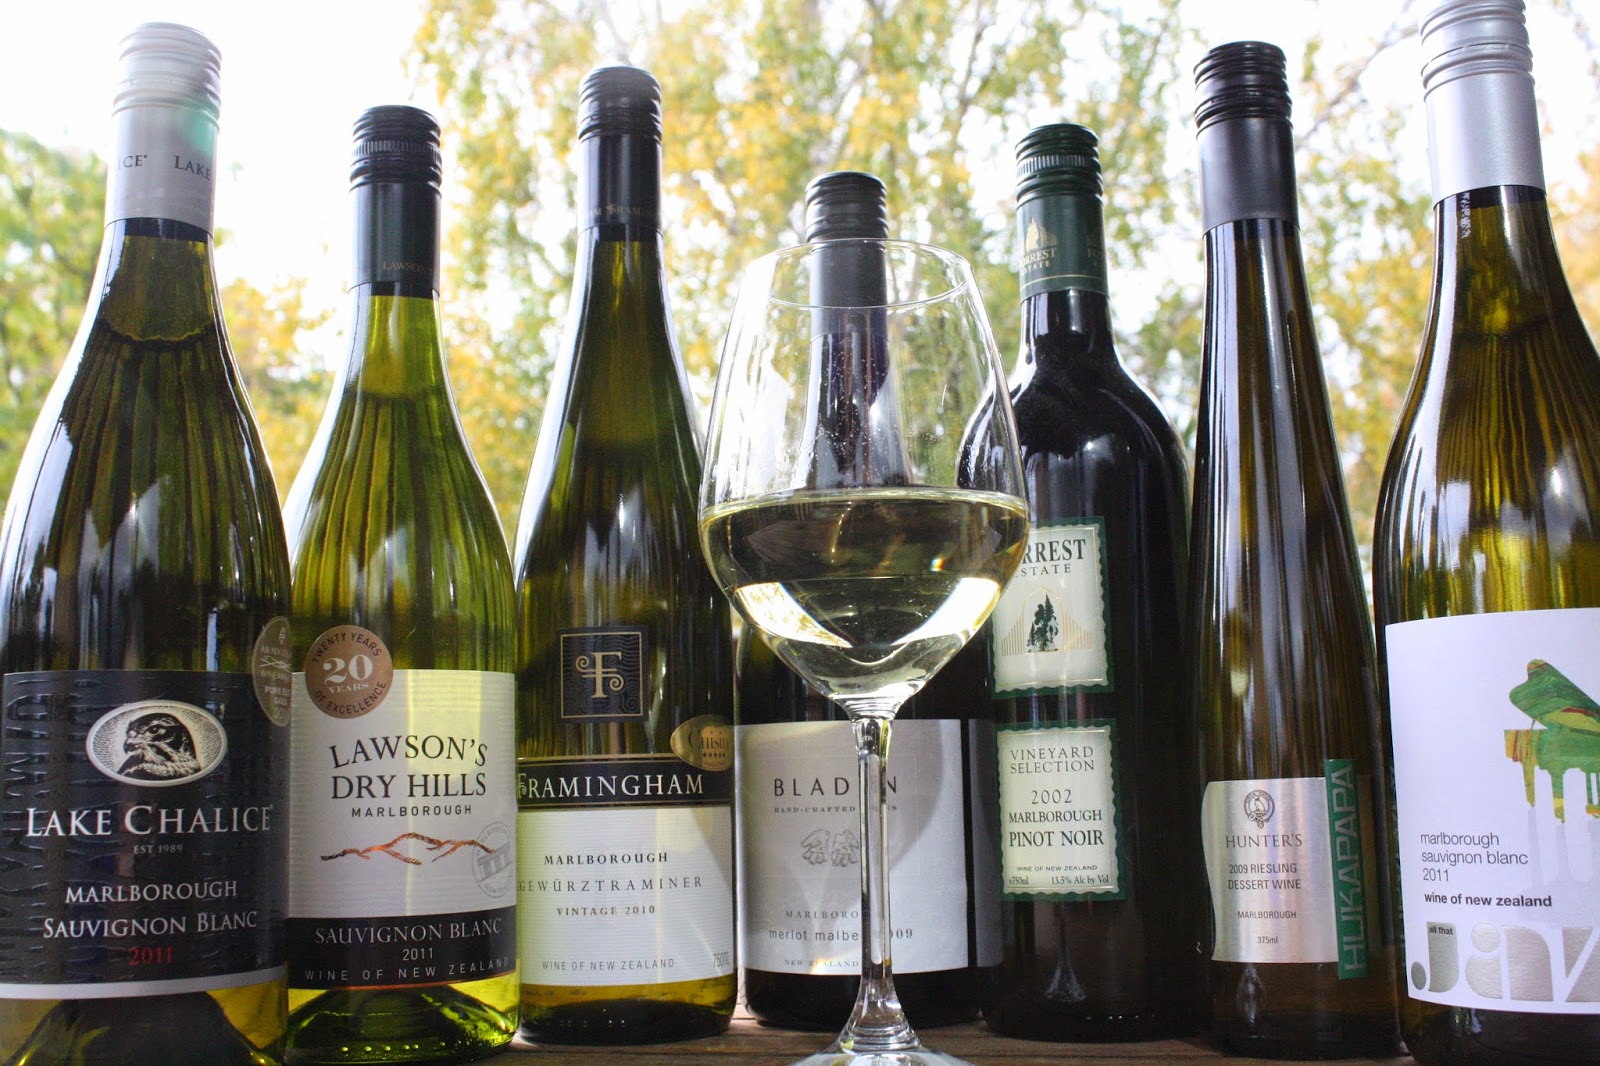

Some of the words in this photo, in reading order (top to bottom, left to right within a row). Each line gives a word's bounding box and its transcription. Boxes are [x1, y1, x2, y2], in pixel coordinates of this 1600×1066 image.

[1022, 539, 1086, 564] RREST
[1014, 564, 1072, 578] STATE
[312, 632, 346, 663] TWENTY
[351, 632, 381, 656] YEARS
[323, 655, 373, 685] 20
[328, 683, 369, 694] YEARS
[315, 690, 326, 702] OF
[327, 682, 386, 714] EXCELLENCE
[329, 735, 488, 769] LAWSON'S
[1010, 746, 1094, 760] VINEYARD
[1010, 760, 1094, 774] SELECTION
[331, 775, 396, 799] DRY
[407, 773, 486, 797] HILLS
[517, 773, 704, 799] FRAMINGHAM
[774, 776, 897, 797] BLADN
[1031, 789, 1072, 804] 2002
[352, 805, 472, 817] MARLBOROUGH
[1009, 809, 1102, 824] MARLBOROUGH
[26, 807, 112, 837] LAKE
[124, 805, 271, 834] CHALICE
[1009, 831, 1054, 847] PINOT
[1061, 829, 1105, 846] NOIR
[1225, 833, 1303, 848] HUNTER'S
[1420, 832, 1500, 848] marlborough
[133, 844, 154, 854] EST
[158, 843, 183, 853] 1989
[544, 853, 668, 865] MARLBOROUGH
[1421, 850, 1482, 866] sauvignon
[1487, 851, 1529, 865] blanc
[1229, 864, 1248, 874] 2009
[1250, 863, 1297, 874] RIESLING
[1331, 764, 1367, 972] HUKAPAPA
[1422, 868, 1449, 882] 2011
[519, 876, 703, 892] GEWÜRZTRAMINER
[1051, 876, 1071, 885] 13.5%
[1074, 876, 1085, 884] Alc
[1087, 875, 1095, 886] by
[1098, 875, 1109, 884] Vol
[1228, 879, 1269, 890] DESSERT
[1272, 879, 1302, 889] WINE
[65, 880, 238, 904] MARLBOROUGH
[1424, 892, 1448, 903] wine
[1451, 894, 1462, 904] of
[1465, 896, 1492, 906] new
[1496, 895, 1552, 907] zealand
[557, 906, 618, 915] VINTAGE
[625, 905, 655, 915] 2010
[785, 910, 859, 919] MARLBORO
[1237, 910, 1297, 919] MARLBOROUGH
[42, 917, 187, 938] SAUVIGNON
[196, 911, 257, 933] BLANC
[315, 924, 443, 944] SAUVIGNON
[450, 917, 502, 940] BLANC
[1428, 926, 1437, 934] all
[1438, 927, 1453, 935] that
[769, 929, 807, 941] merlot
[815, 930, 859, 941] malbe
[1257, 936, 1278, 944] 375ml
[128, 946, 173, 965] 2011
[402, 948, 433, 961] 2011
[305, 969, 348, 981] WINE
[362, 969, 383, 980] OF
[398, 966, 435, 978] NEW
[449, 958, 508, 975] ZEALAND
[542, 961, 566, 971] WINE
[571, 961, 585, 971] OF
[590, 961, 616, 970] NEW
[620, 958, 674, 970] ZEALAND
[784, 959, 804, 967] NEW
[809, 959, 859, 967] ZALAND
